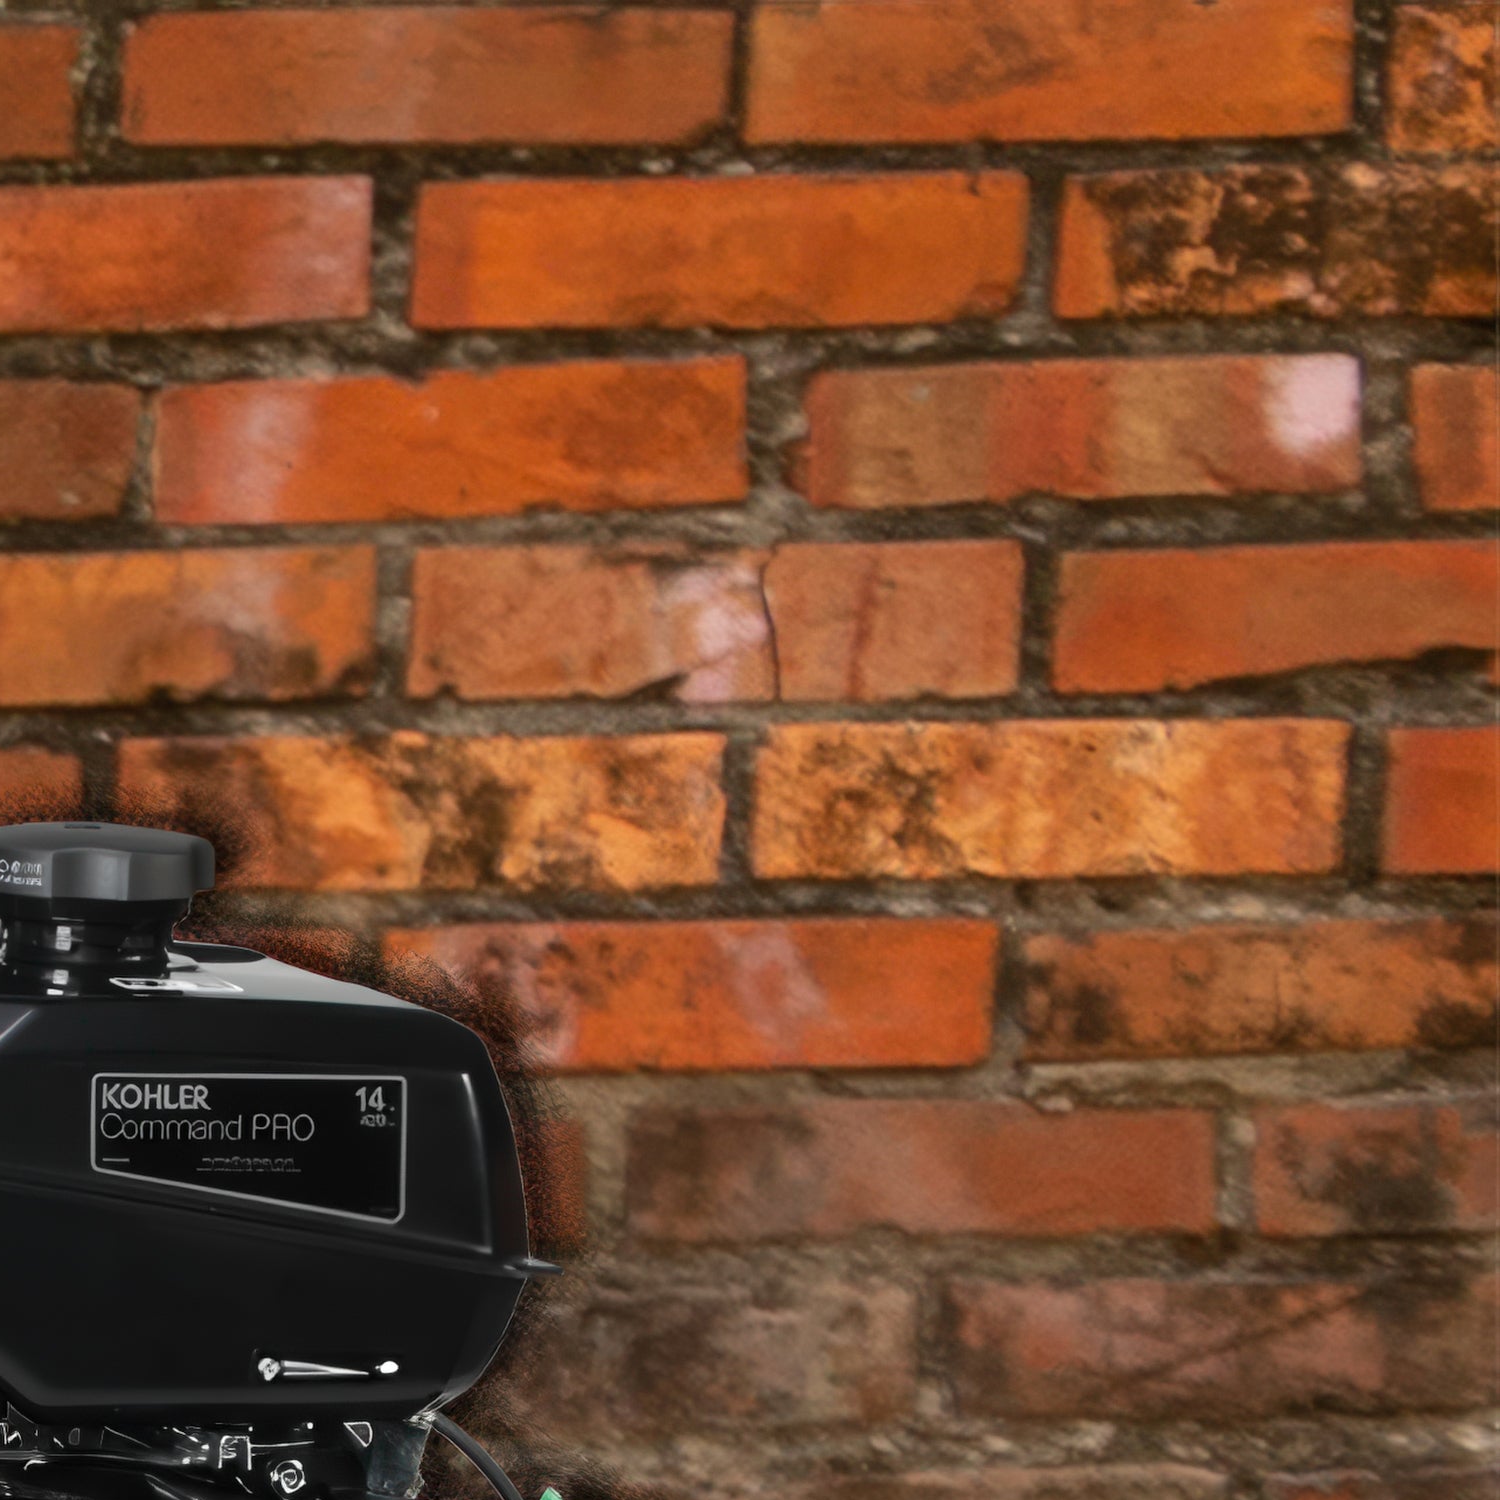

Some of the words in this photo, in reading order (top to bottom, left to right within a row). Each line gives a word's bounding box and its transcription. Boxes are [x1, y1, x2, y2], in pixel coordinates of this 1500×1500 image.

[102, 1083, 211, 1110] KOHLER
[100, 1113, 242, 1140] Command
[251, 1113, 315, 1142] PRO
